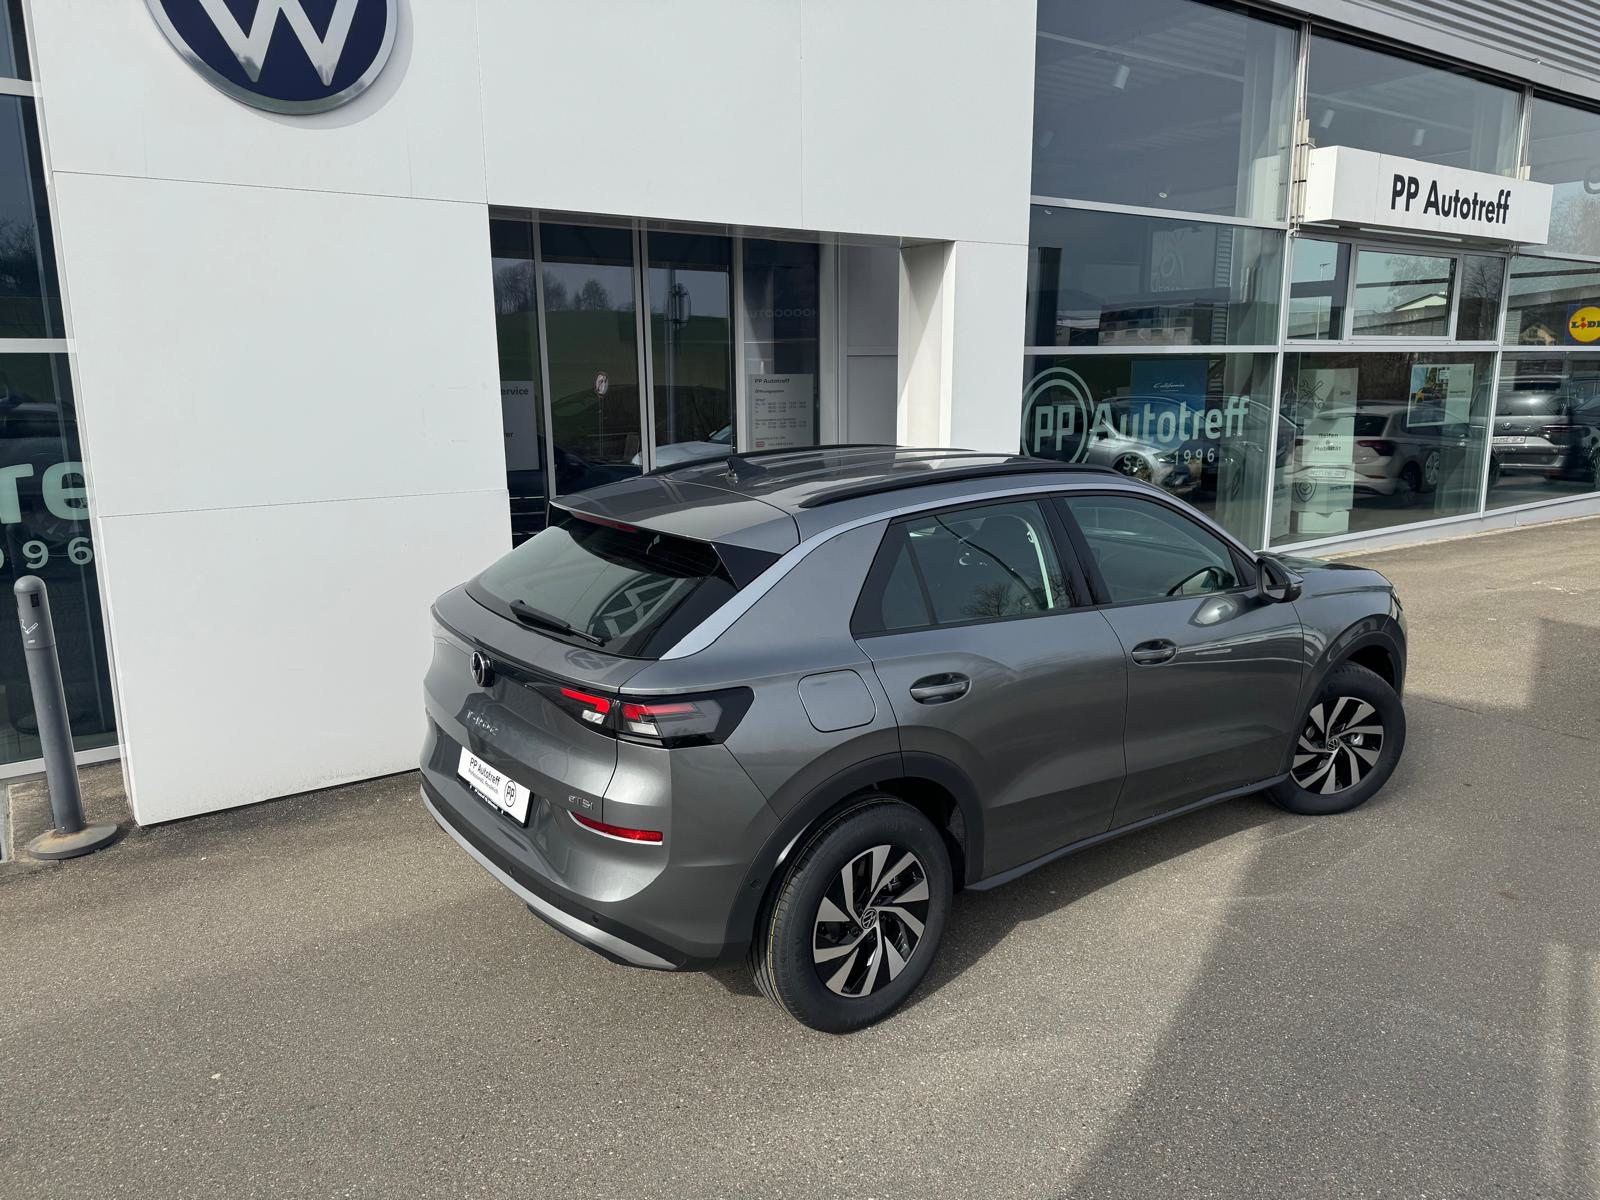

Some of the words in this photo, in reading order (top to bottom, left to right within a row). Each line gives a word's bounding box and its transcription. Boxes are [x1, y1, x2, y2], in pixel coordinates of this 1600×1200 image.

[1390, 173, 1420, 212] PP
[1423, 179, 1512, 225] Autotreff
[501, 385, 529, 396] ervice
[1034, 405, 1076, 453] PP
[1087, 396, 1250, 449] Autotreff
[1174, 447, 1216, 466] 1996
[0, 537, 93, 570] 96
[469, 756, 478, 769] PP
[478, 764, 501, 786] Autotreff
[505, 785, 515, 801] PP
